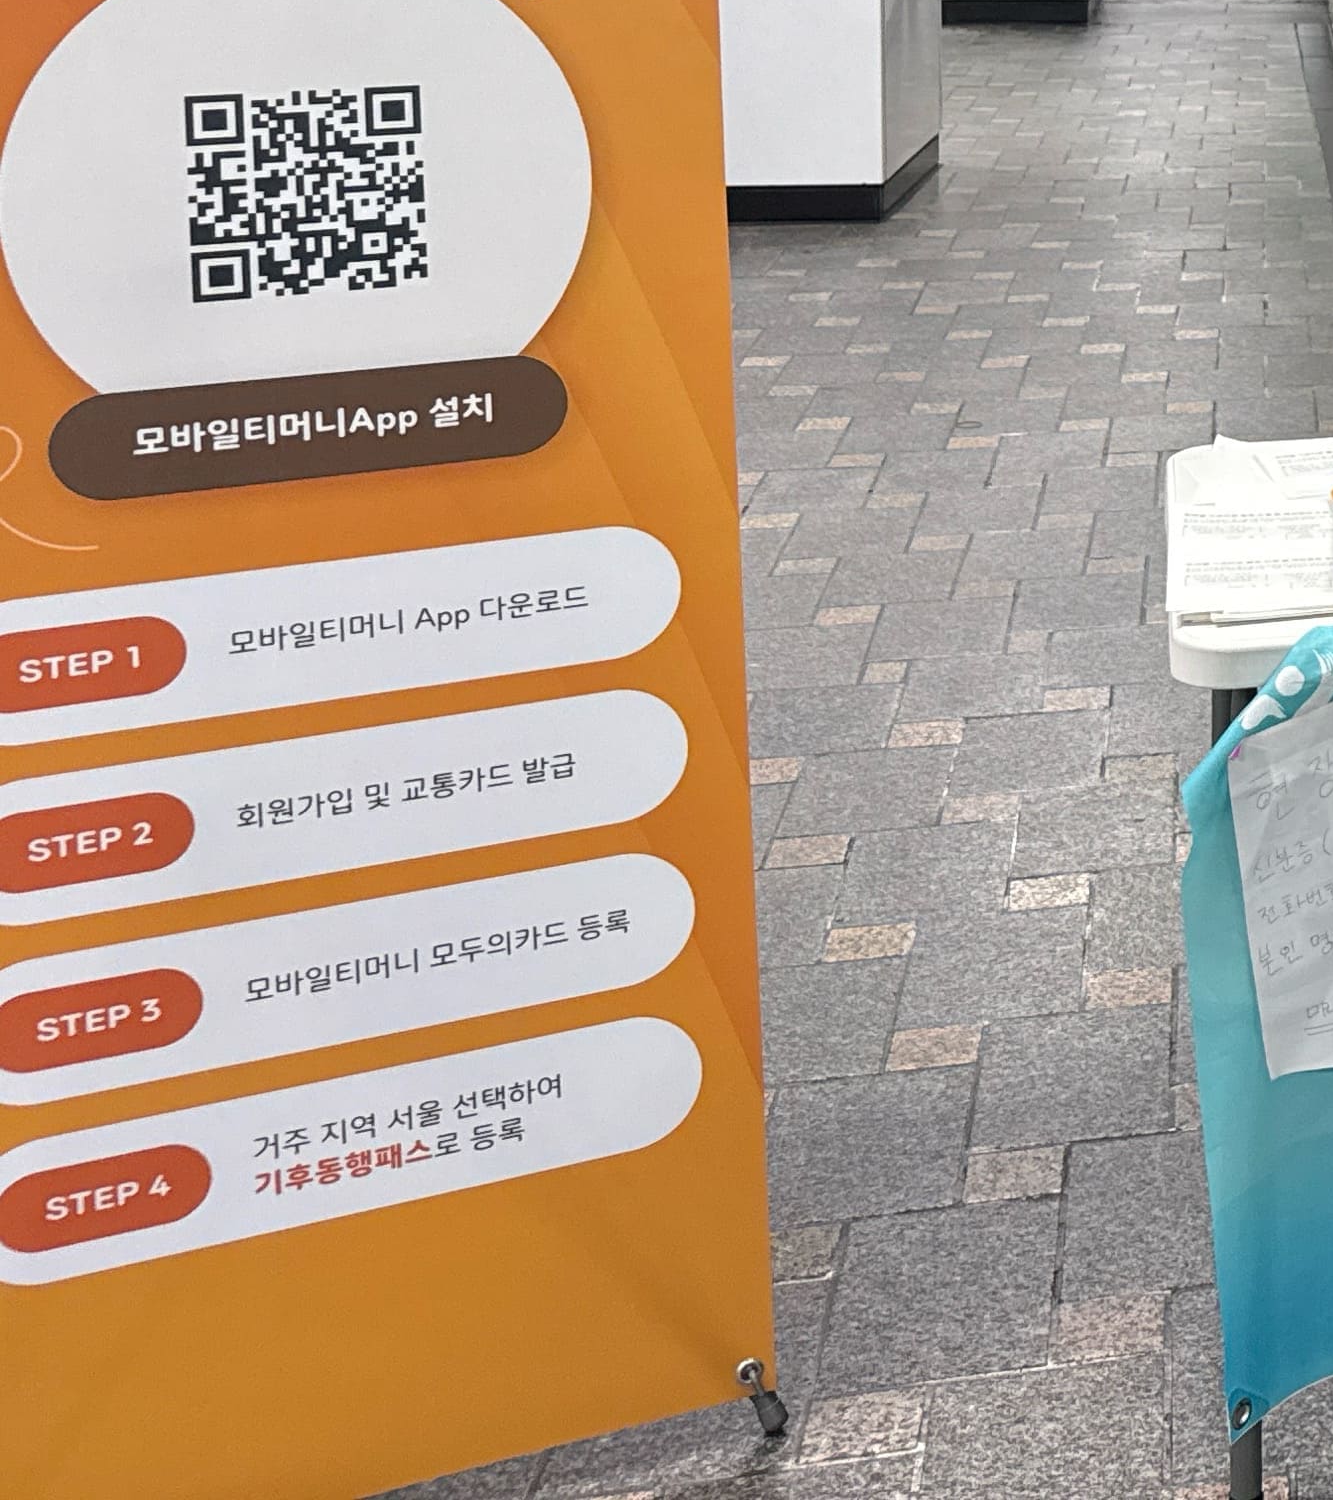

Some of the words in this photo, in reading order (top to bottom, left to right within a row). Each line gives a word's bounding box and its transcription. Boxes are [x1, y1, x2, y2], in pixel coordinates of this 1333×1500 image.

[132, 405, 418, 456] 모바일티머니App
[429, 393, 494, 427] 설치
[228, 609, 404, 657] 모바일티머니
[415, 604, 470, 631] App
[479, 585, 589, 622] 다운로드
[18, 649, 114, 684] STEP
[127, 646, 142, 669] 1
[236, 788, 354, 829] 회원가입
[364, 782, 391, 810] 및
[401, 763, 513, 803] 교통카드
[521, 752, 576, 782] 발급
[27, 828, 123, 863] STEP
[133, 821, 154, 846] 2
[1253, 842, 1313, 883] 신분증
[244, 950, 420, 1003] 모바일티머니
[430, 923, 568, 968] 모두의카드
[577, 909, 630, 941] 등록
[35, 1005, 131, 1042] STEP
[141, 998, 163, 1024] 3
[253, 1128, 310, 1160] 거주
[320, 1115, 377, 1146] 지역
[387, 1099, 443, 1133] 서울
[452, 1074, 564, 1120] 선택하여
[253, 1133, 462, 1197] 기후동행패스로
[469, 1117, 525, 1151] 등록
[44, 1182, 140, 1221] STEP
[150, 1176, 172, 1201] 4
